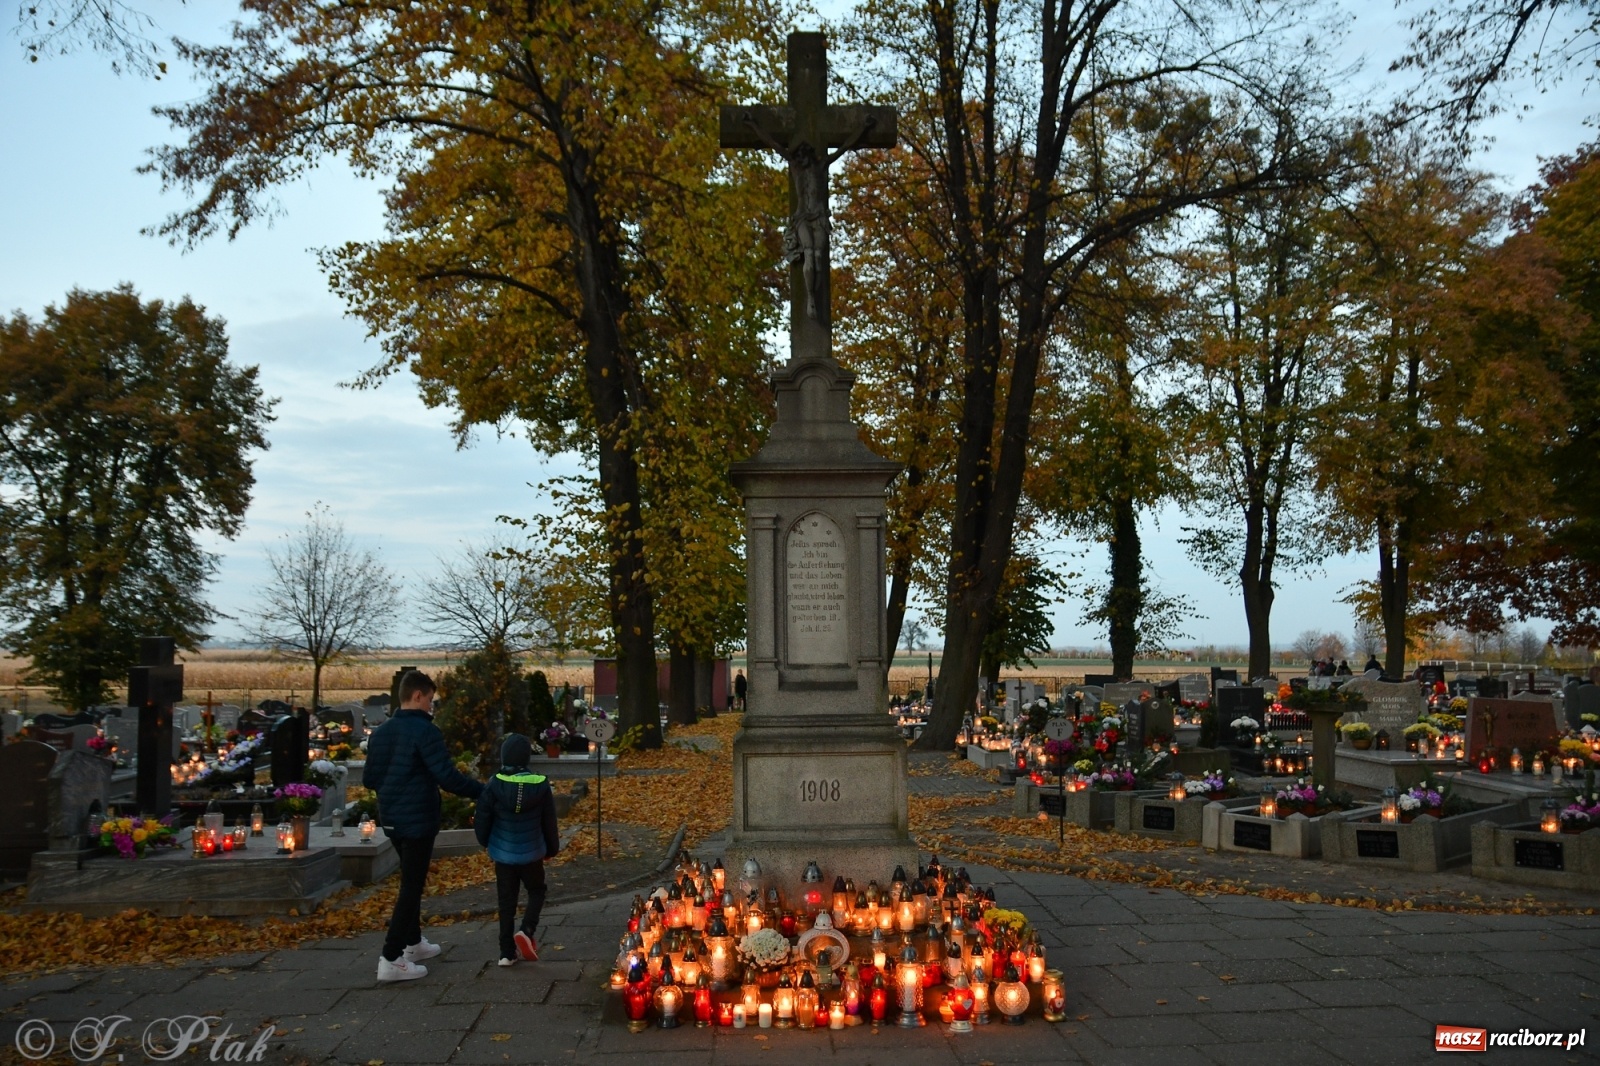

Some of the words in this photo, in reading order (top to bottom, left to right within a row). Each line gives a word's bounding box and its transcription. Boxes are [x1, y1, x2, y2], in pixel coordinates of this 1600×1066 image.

[595, 728, 603, 738] G
[1057, 728, 1064, 737] F
[800, 779, 841, 802] 1908
